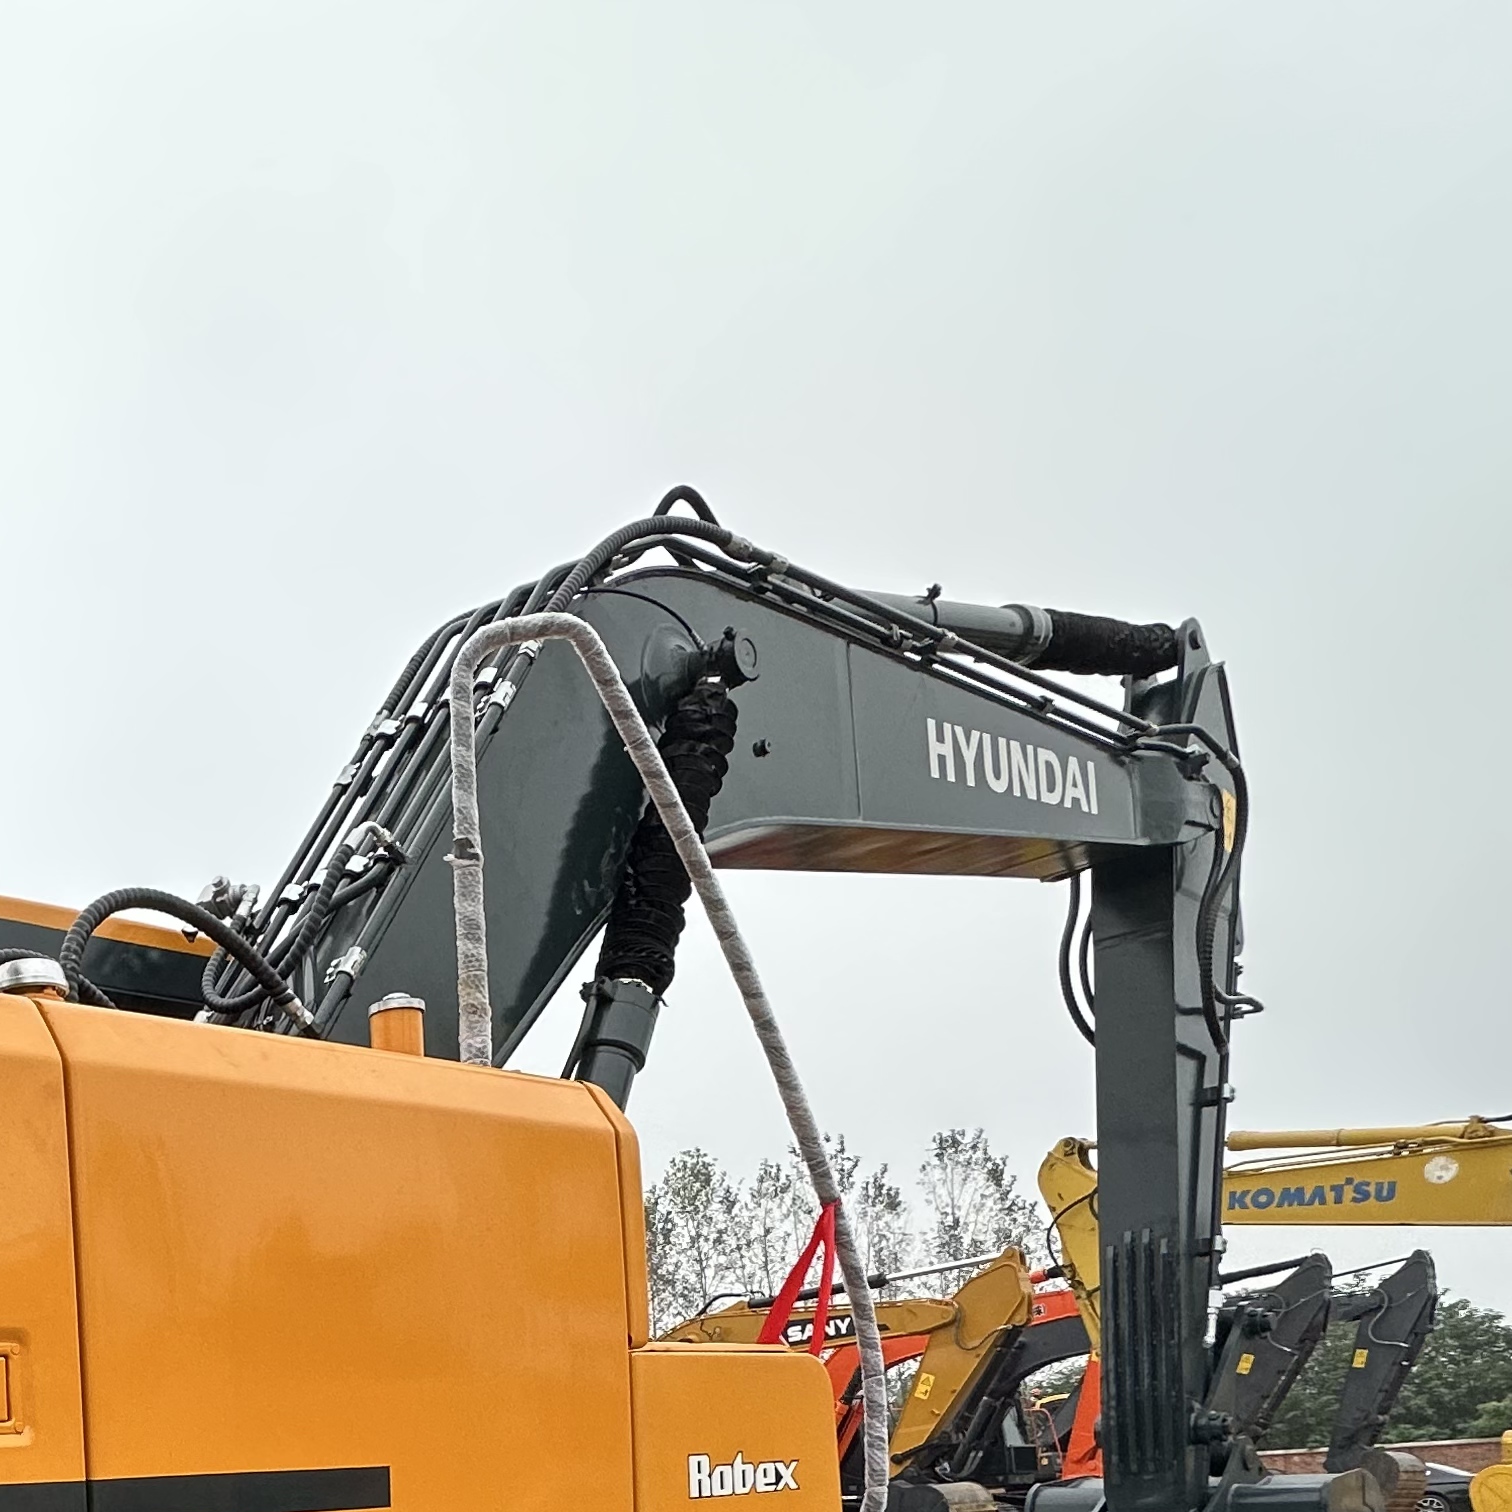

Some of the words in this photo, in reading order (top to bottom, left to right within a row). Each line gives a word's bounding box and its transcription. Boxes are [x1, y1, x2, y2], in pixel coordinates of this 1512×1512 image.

[926, 717, 1099, 815] HYUNDAI
[1227, 1177, 1396, 1210] KOMATSU
[688, 1450, 800, 1499] Robex
